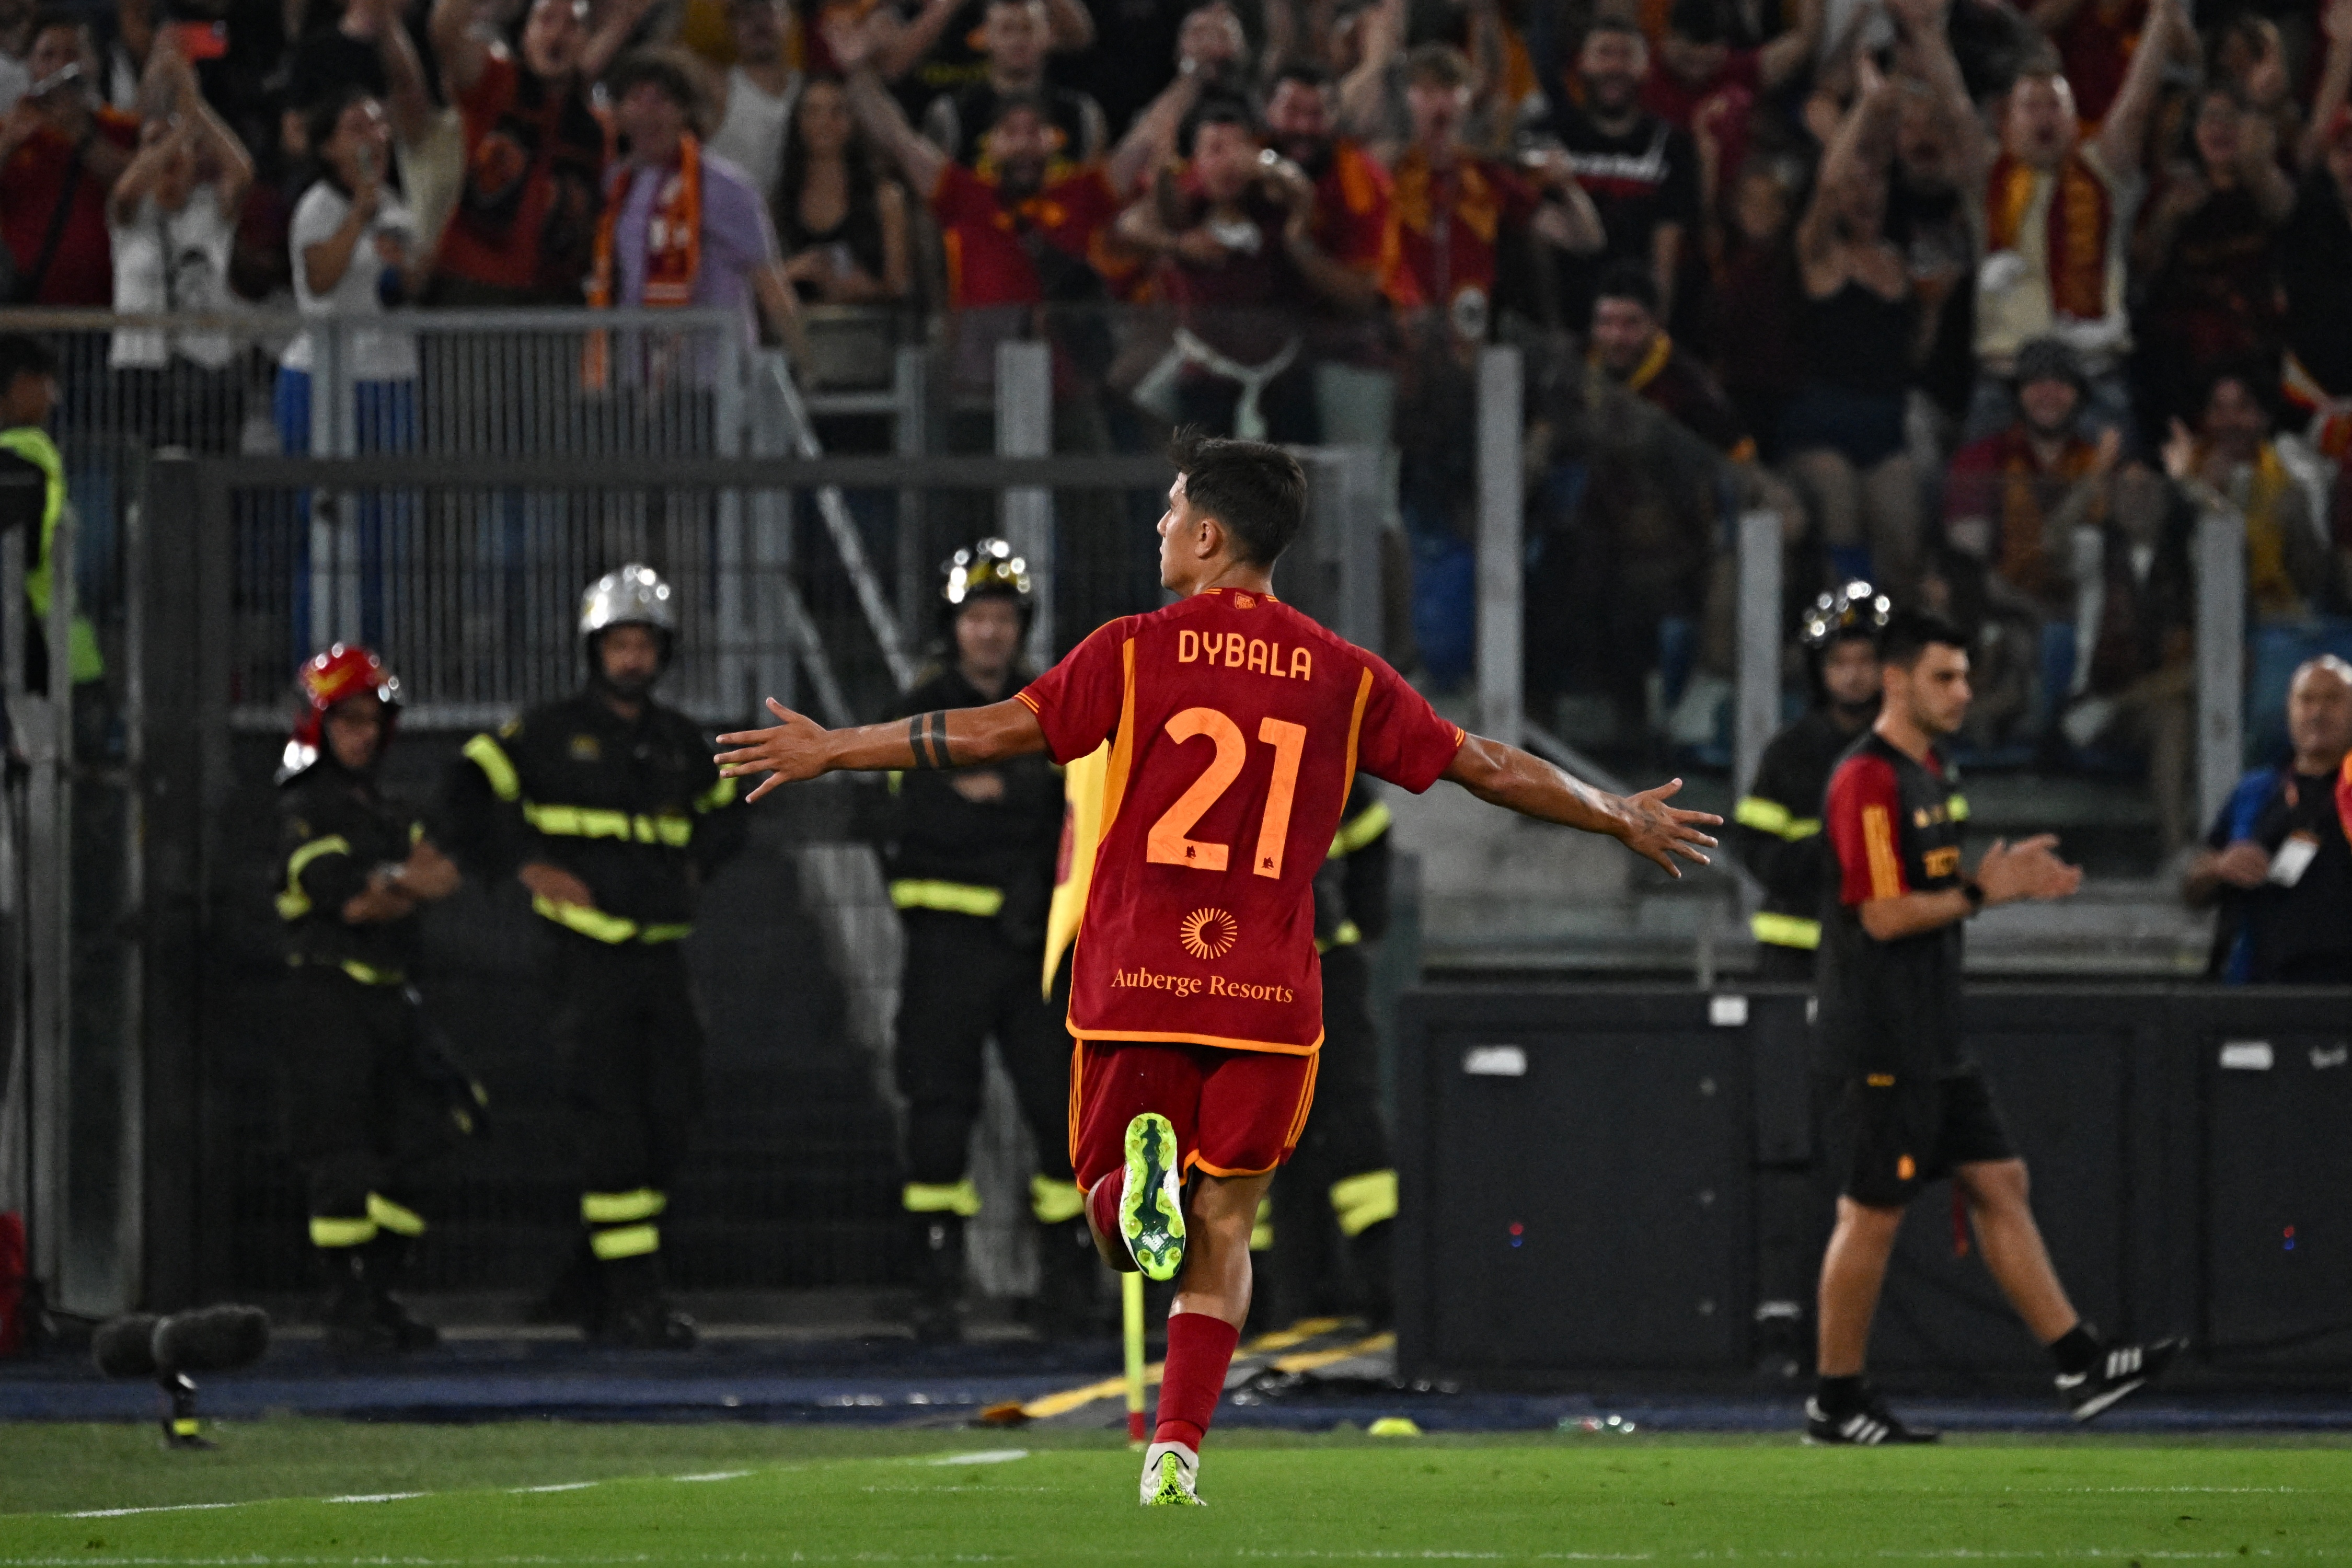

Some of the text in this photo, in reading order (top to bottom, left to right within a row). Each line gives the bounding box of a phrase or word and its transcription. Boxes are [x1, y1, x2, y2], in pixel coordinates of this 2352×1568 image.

[1179, 630, 1311, 681] DYBALA
[1147, 708, 1306, 879] 21
[1110, 967, 1293, 1003] Auberge Resorts
